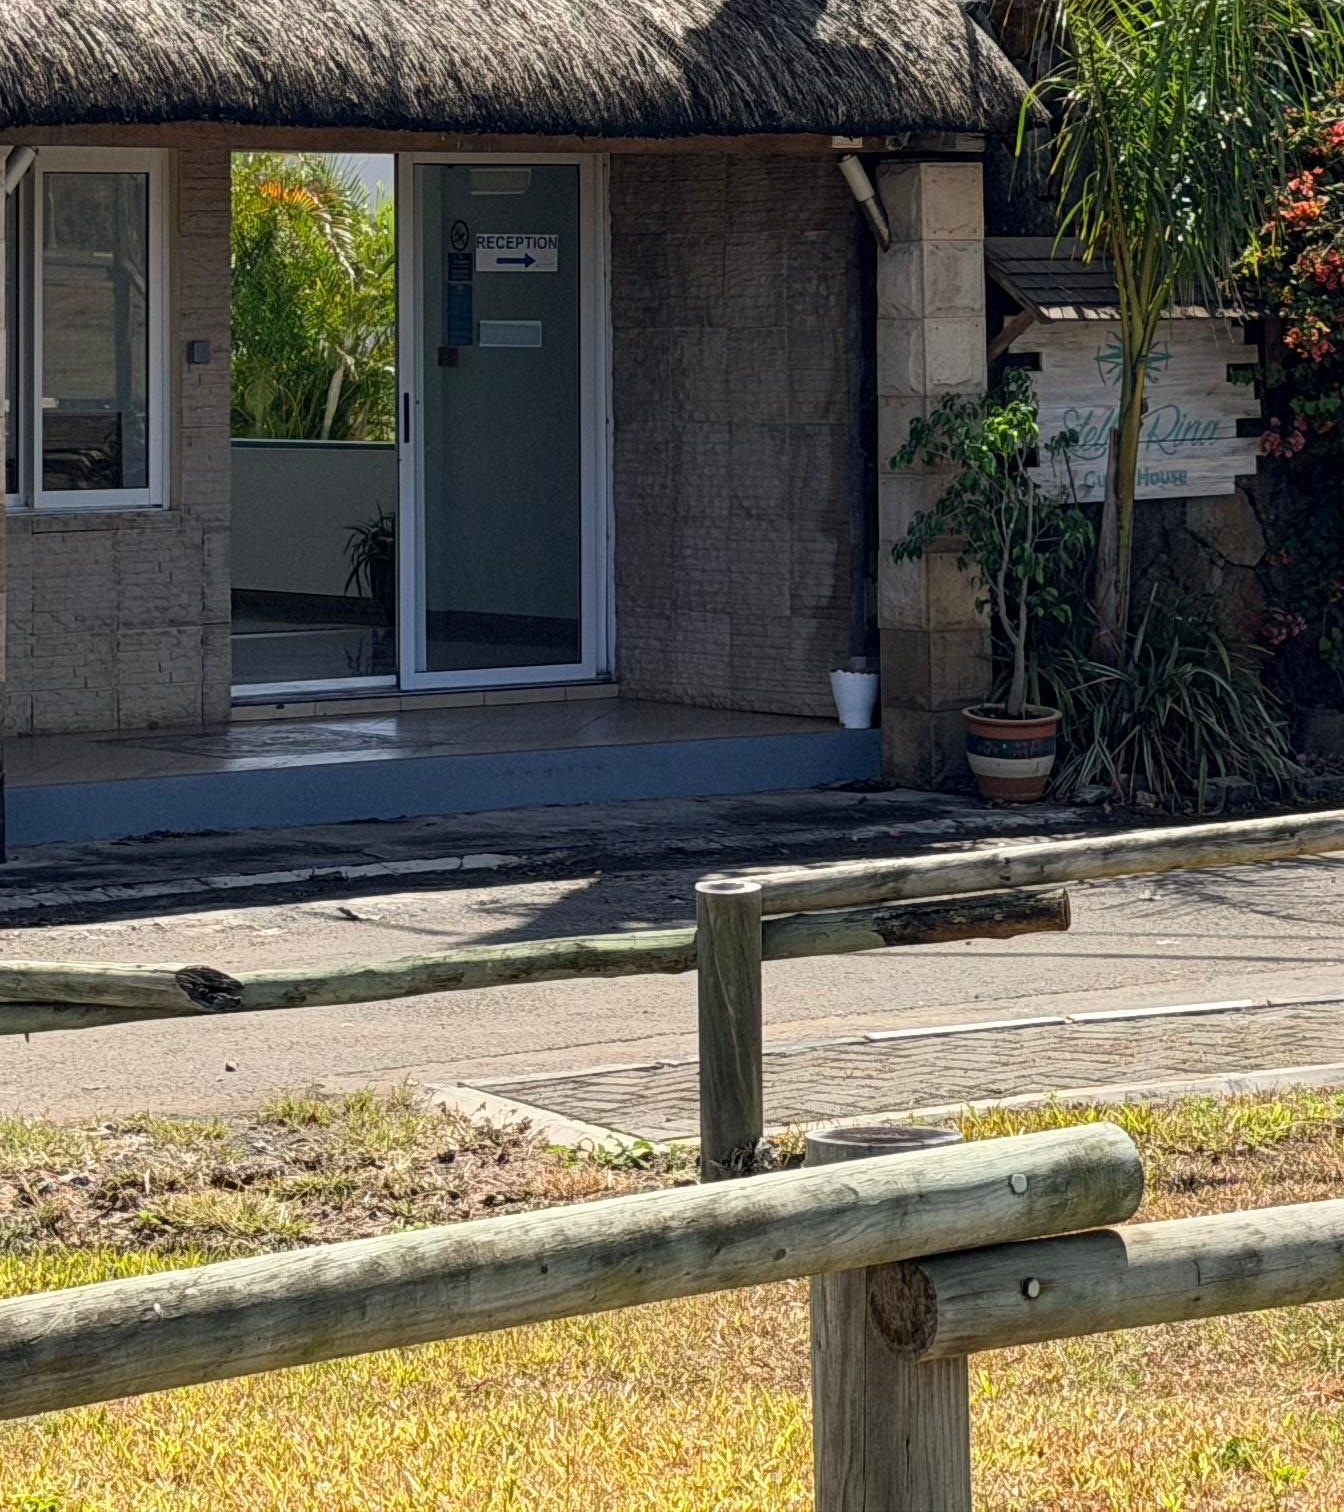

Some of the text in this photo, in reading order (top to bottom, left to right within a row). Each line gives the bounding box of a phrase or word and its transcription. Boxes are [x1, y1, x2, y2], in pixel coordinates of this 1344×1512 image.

[476, 235, 558, 250] RECEPTION
[1140, 404, 1219, 456] Rina
[1136, 468, 1188, 486] House
